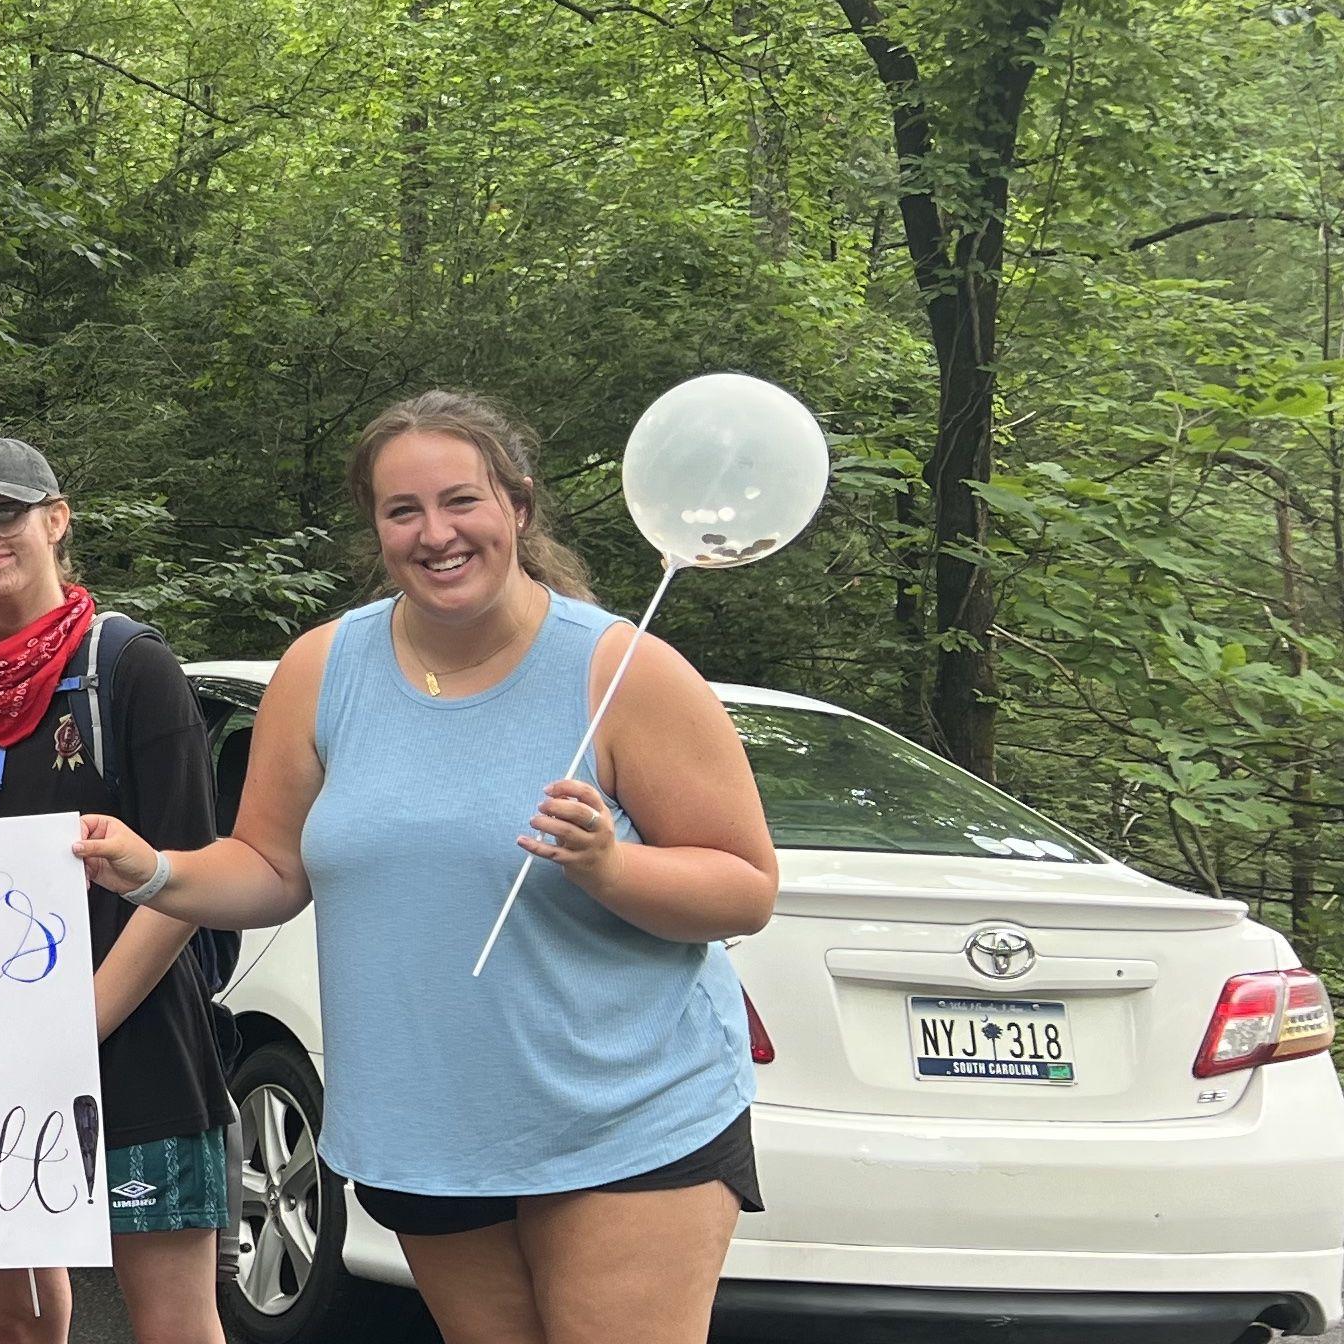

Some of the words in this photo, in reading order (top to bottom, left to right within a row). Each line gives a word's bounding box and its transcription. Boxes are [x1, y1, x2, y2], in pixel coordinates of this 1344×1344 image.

[920, 1018, 978, 1057] NYJ
[1007, 1022, 1063, 1060] 318
[952, 1061, 986, 1075] SOUTH
[988, 1063, 1040, 1077] CAROLINA
[112, 1197, 157, 1208] UMBRO
